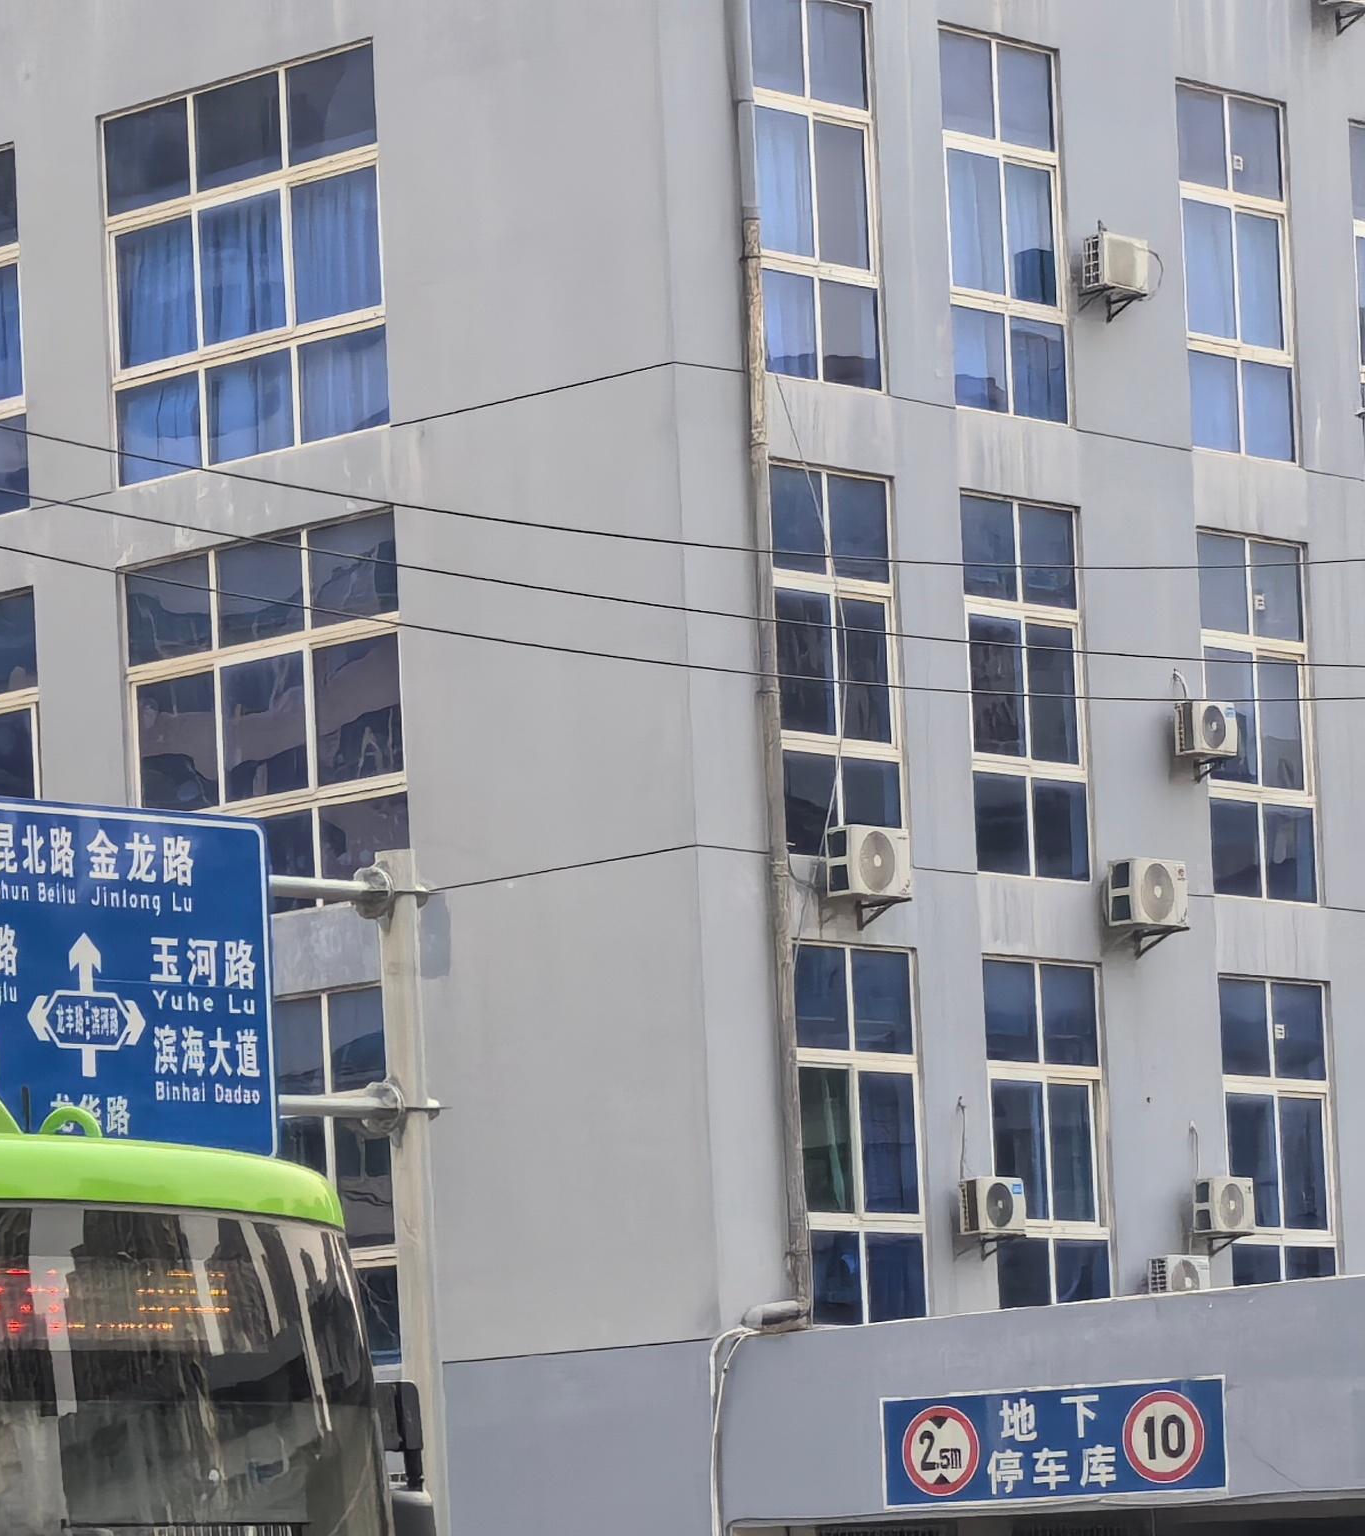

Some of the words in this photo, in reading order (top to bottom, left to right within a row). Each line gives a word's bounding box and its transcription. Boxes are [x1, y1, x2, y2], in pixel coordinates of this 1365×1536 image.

[87, 829, 195, 888] 金龙路
[37, 881, 76, 905] Beilu
[91, 886, 161, 916] Jinlong
[172, 891, 193, 913] Lu
[149, 936, 256, 990] 玉河路
[152, 989, 214, 1012] Yuhe
[229, 993, 256, 1015] Lu
[154, 1024, 260, 1077] 滨海大道
[155, 1080, 206, 1102] Binhai
[214, 1083, 260, 1104] Dadao
[999, 1393, 1100, 1443] 地下
[1142, 1413, 1186, 1461] 10
[986, 1444, 1117, 1495] 停车库
